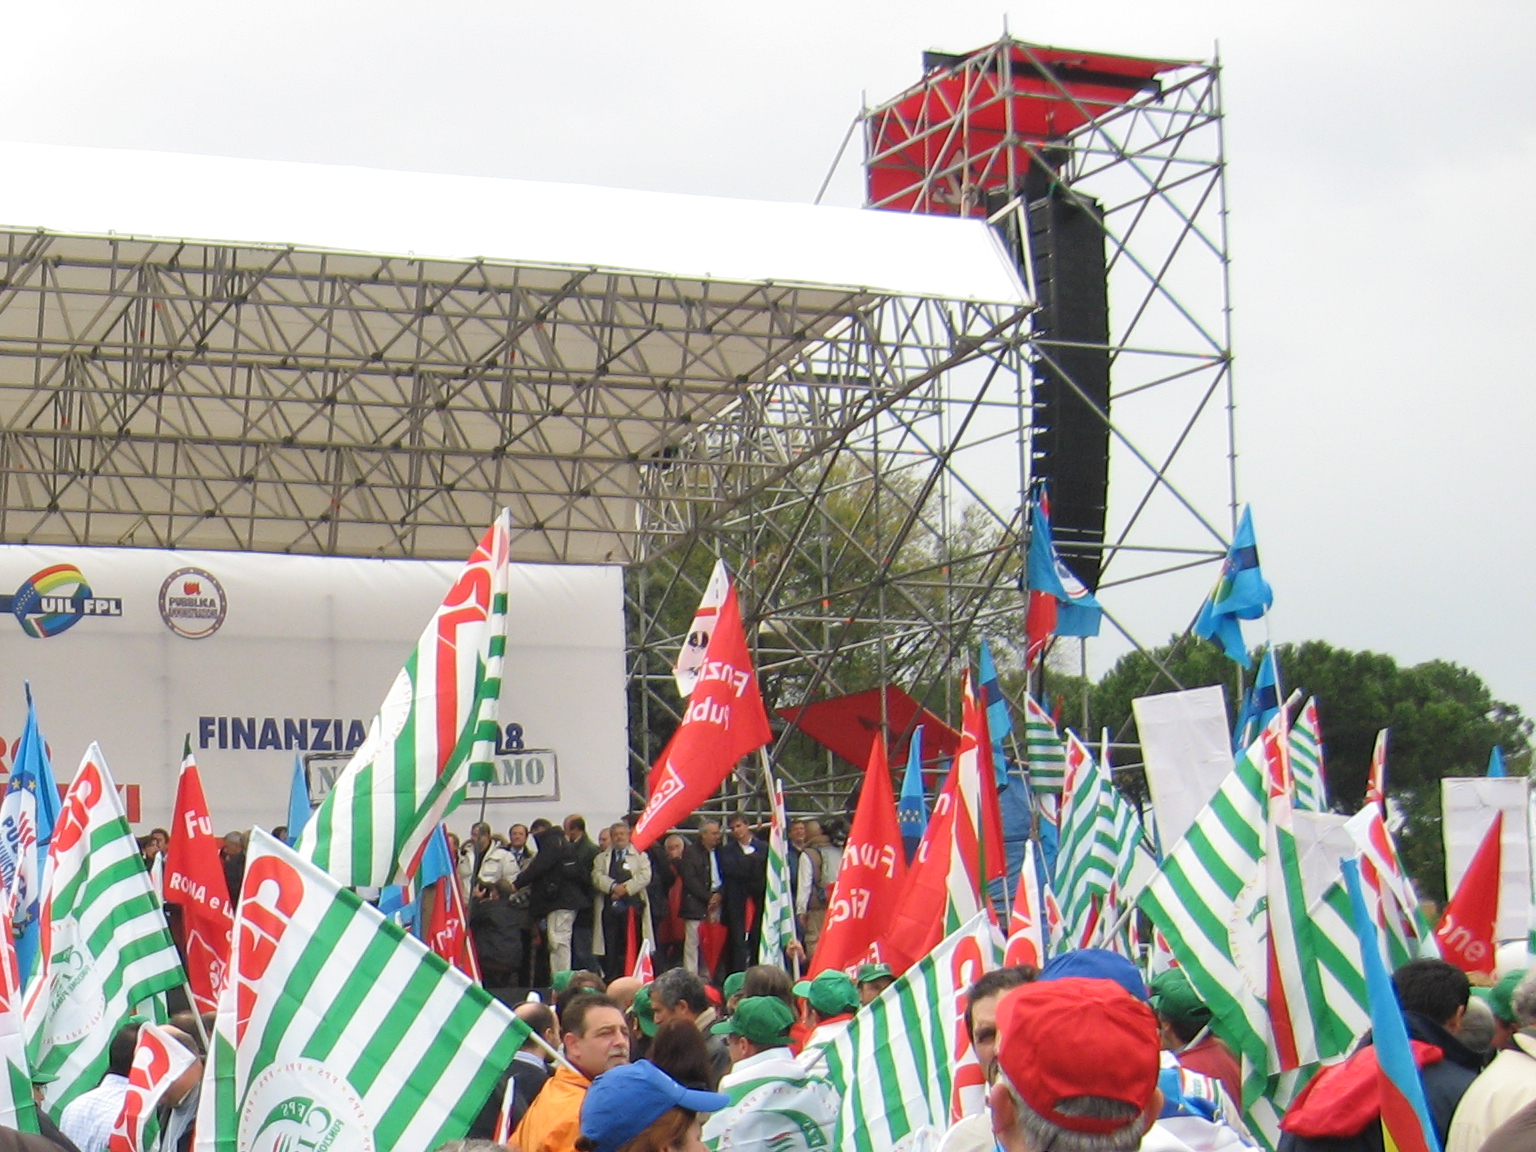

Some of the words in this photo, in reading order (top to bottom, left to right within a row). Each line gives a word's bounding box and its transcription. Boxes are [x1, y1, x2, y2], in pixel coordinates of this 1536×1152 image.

[40, 597, 76, 614] UIL
[83, 598, 121, 615] FPL
[198, 716, 371, 751] FINANZIA
